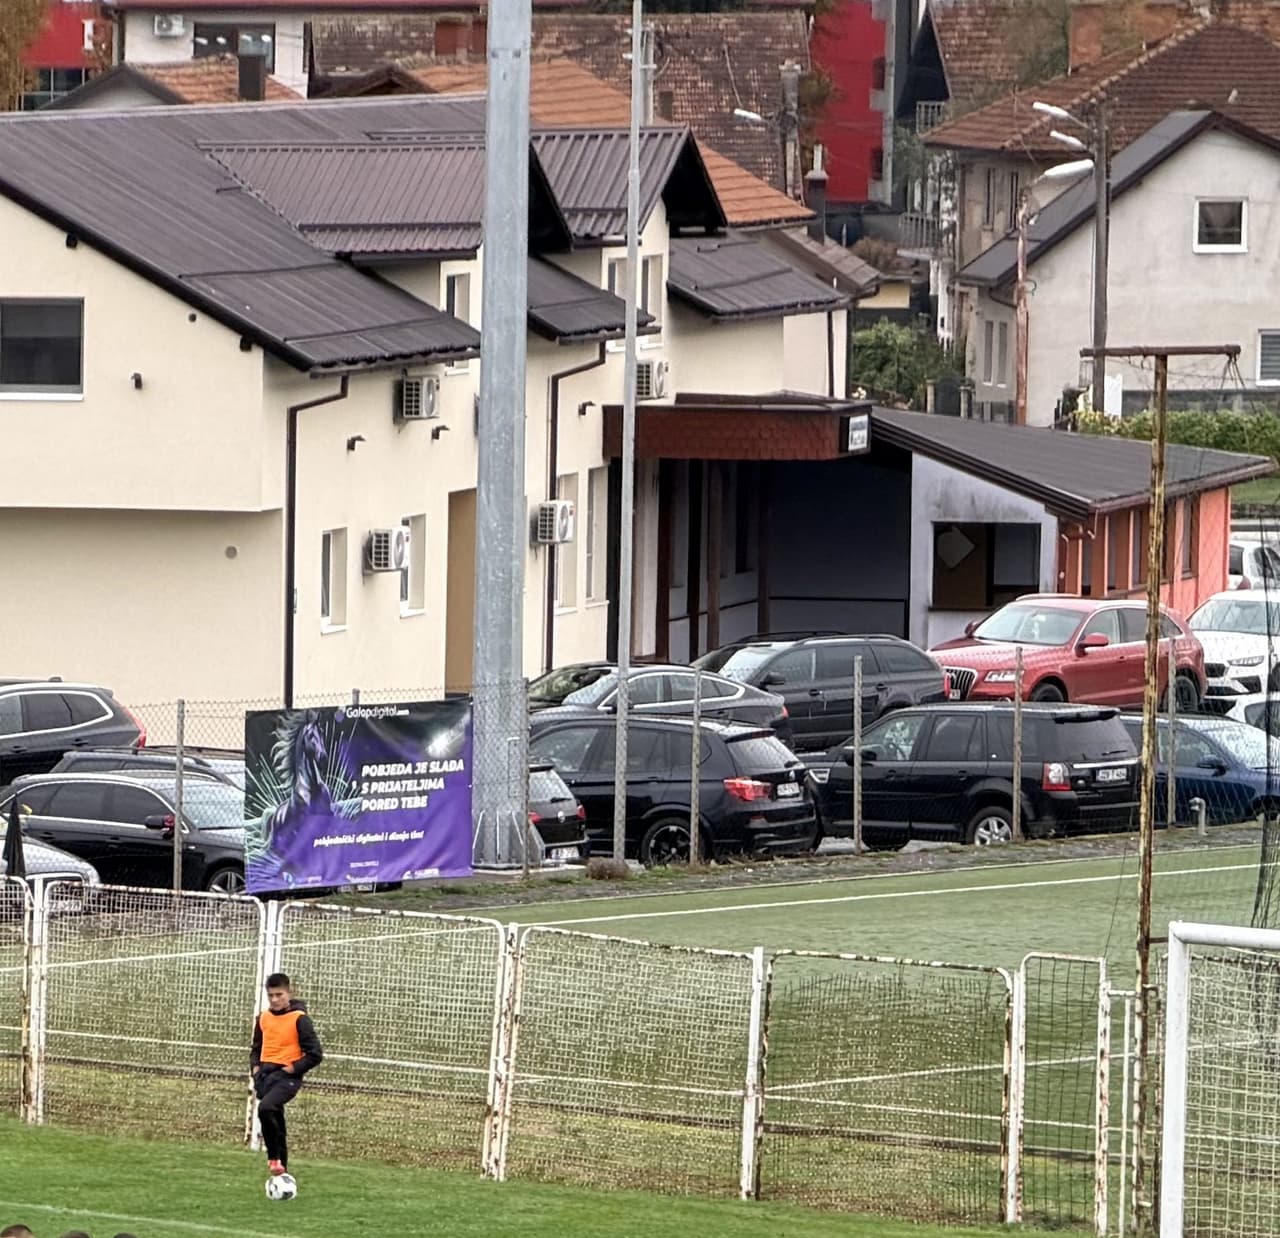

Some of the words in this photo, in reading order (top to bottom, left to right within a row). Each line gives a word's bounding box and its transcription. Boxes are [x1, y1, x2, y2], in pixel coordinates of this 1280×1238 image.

[362, 763, 413, 777] POBJEDA
[414, 761, 428, 775] JE
[360, 782, 370, 794] S
[370, 777, 445, 794] PRIJATELJIMA
[361, 797, 399, 811] PORED
[401, 796, 428, 809] TEBE
